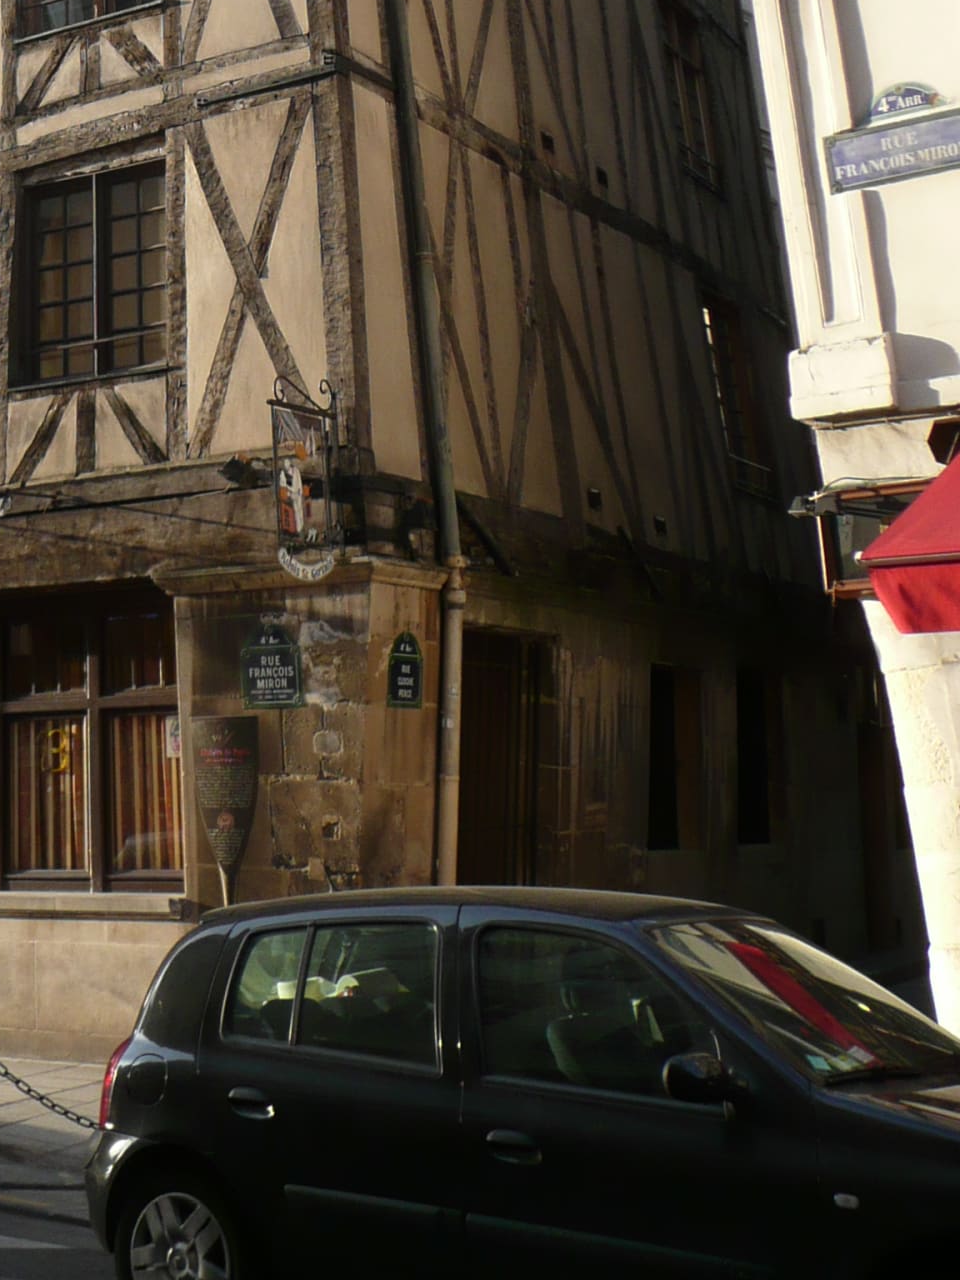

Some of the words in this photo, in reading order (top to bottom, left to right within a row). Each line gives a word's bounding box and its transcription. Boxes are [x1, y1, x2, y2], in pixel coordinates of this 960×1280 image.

[880, 130, 918, 151] RUE
[835, 151, 915, 180] FRANÇOIS
[916, 141, 960, 161] MIRO
[260, 655, 280, 666] RUE
[249, 666, 294, 678] FRANÇOIS
[256, 678, 288, 689] MIRON
